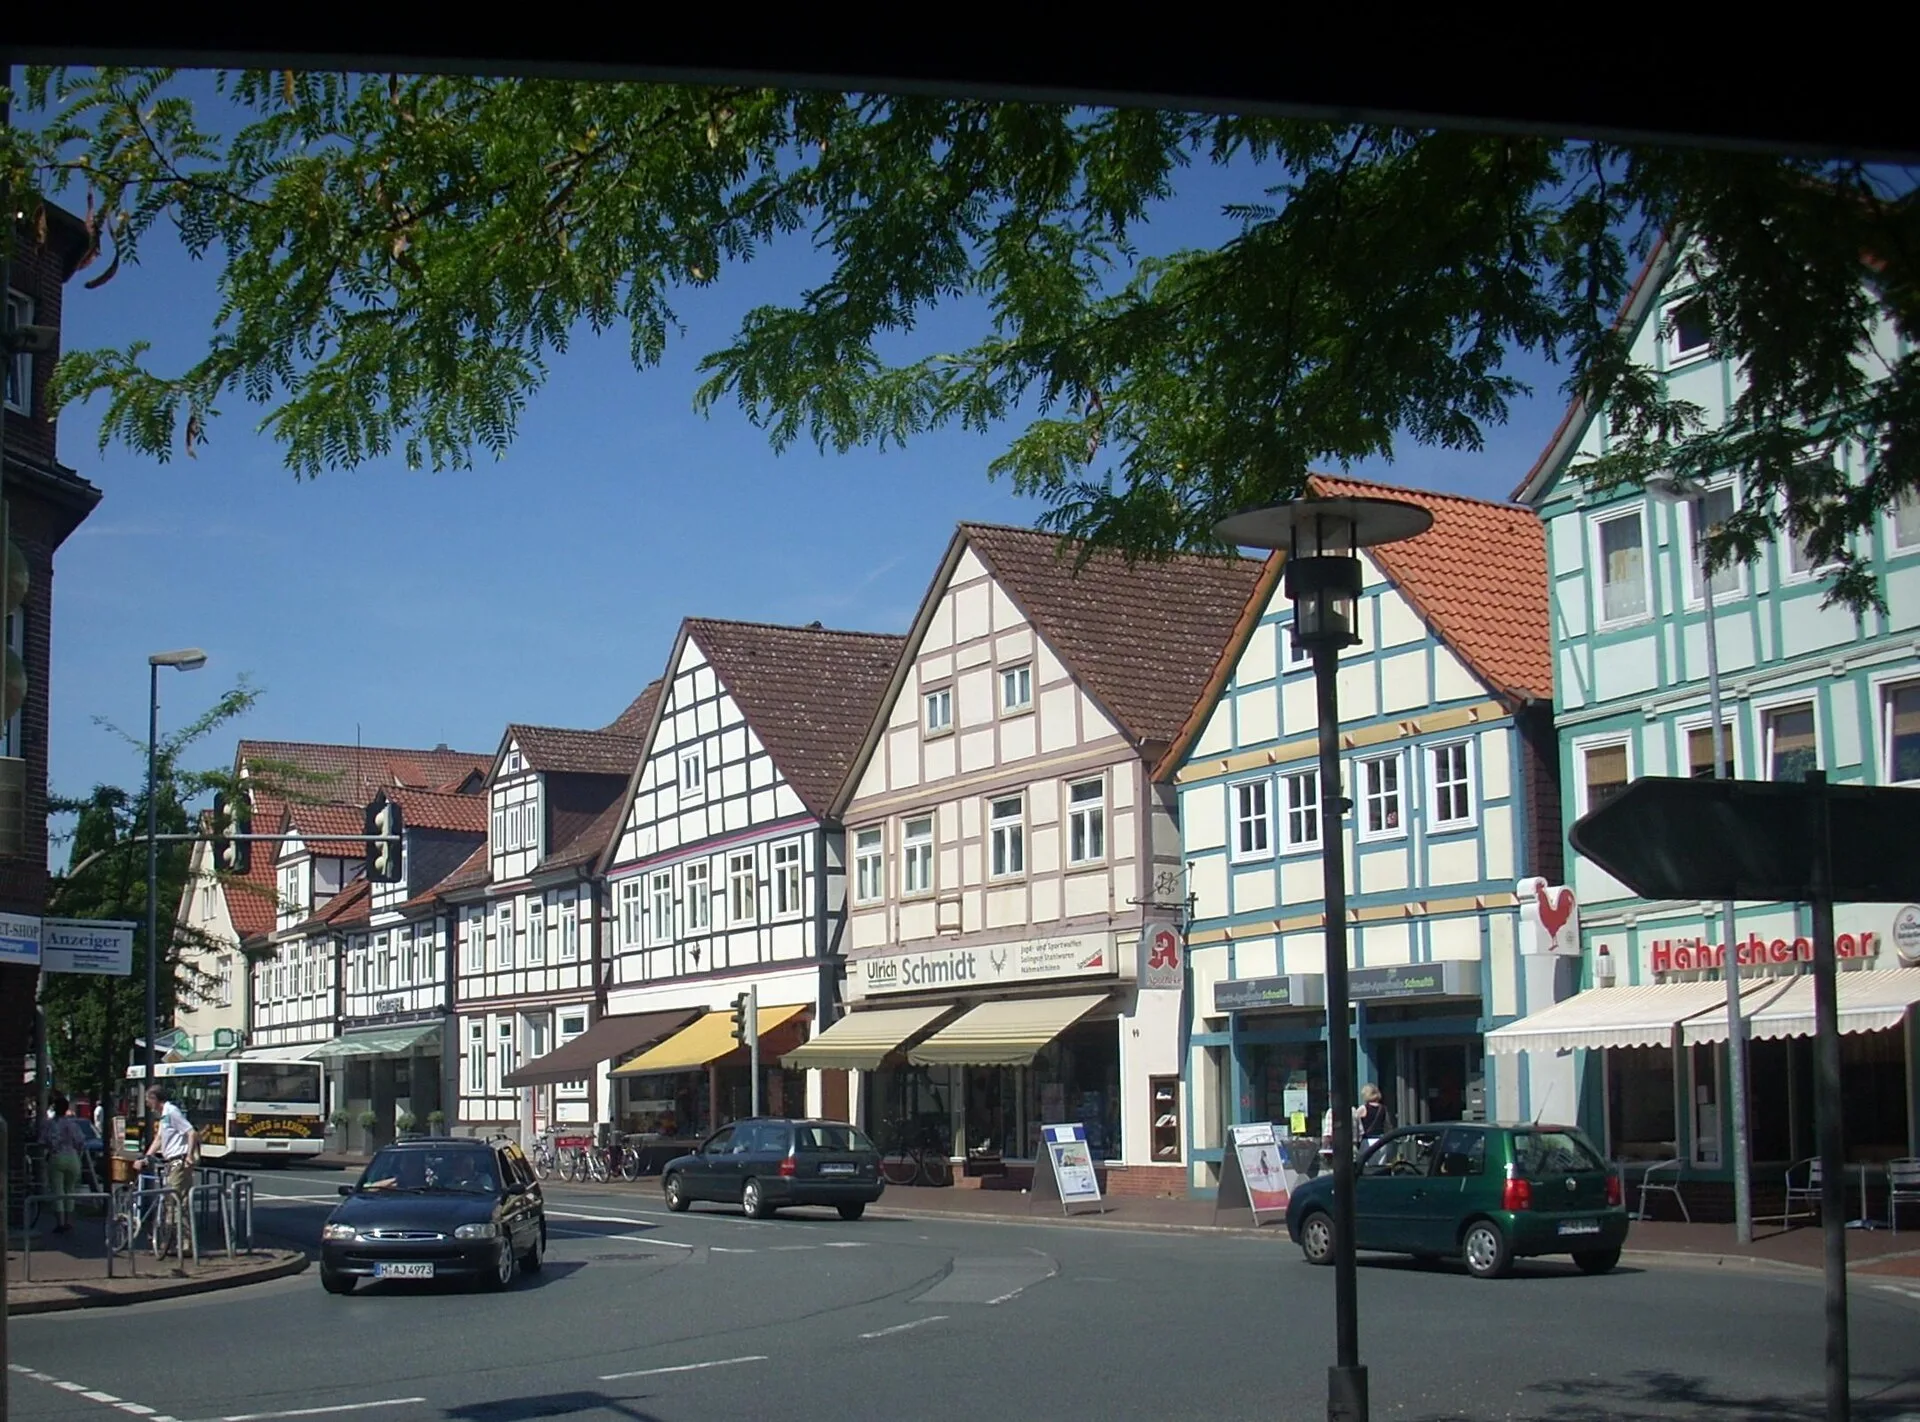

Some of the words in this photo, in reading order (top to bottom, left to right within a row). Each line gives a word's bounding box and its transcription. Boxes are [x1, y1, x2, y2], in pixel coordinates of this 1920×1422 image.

[47, 931, 121, 950] Anzeiger
[1651, 931, 1875, 972] Hähnchenar
[867, 959, 897, 979] Ulrich
[902, 951, 976, 985] Schmidt
[381, 1265, 388, 1274] H
[393, 1265, 406, 1275] AJ
[408, 1265, 433, 1275] 4973
